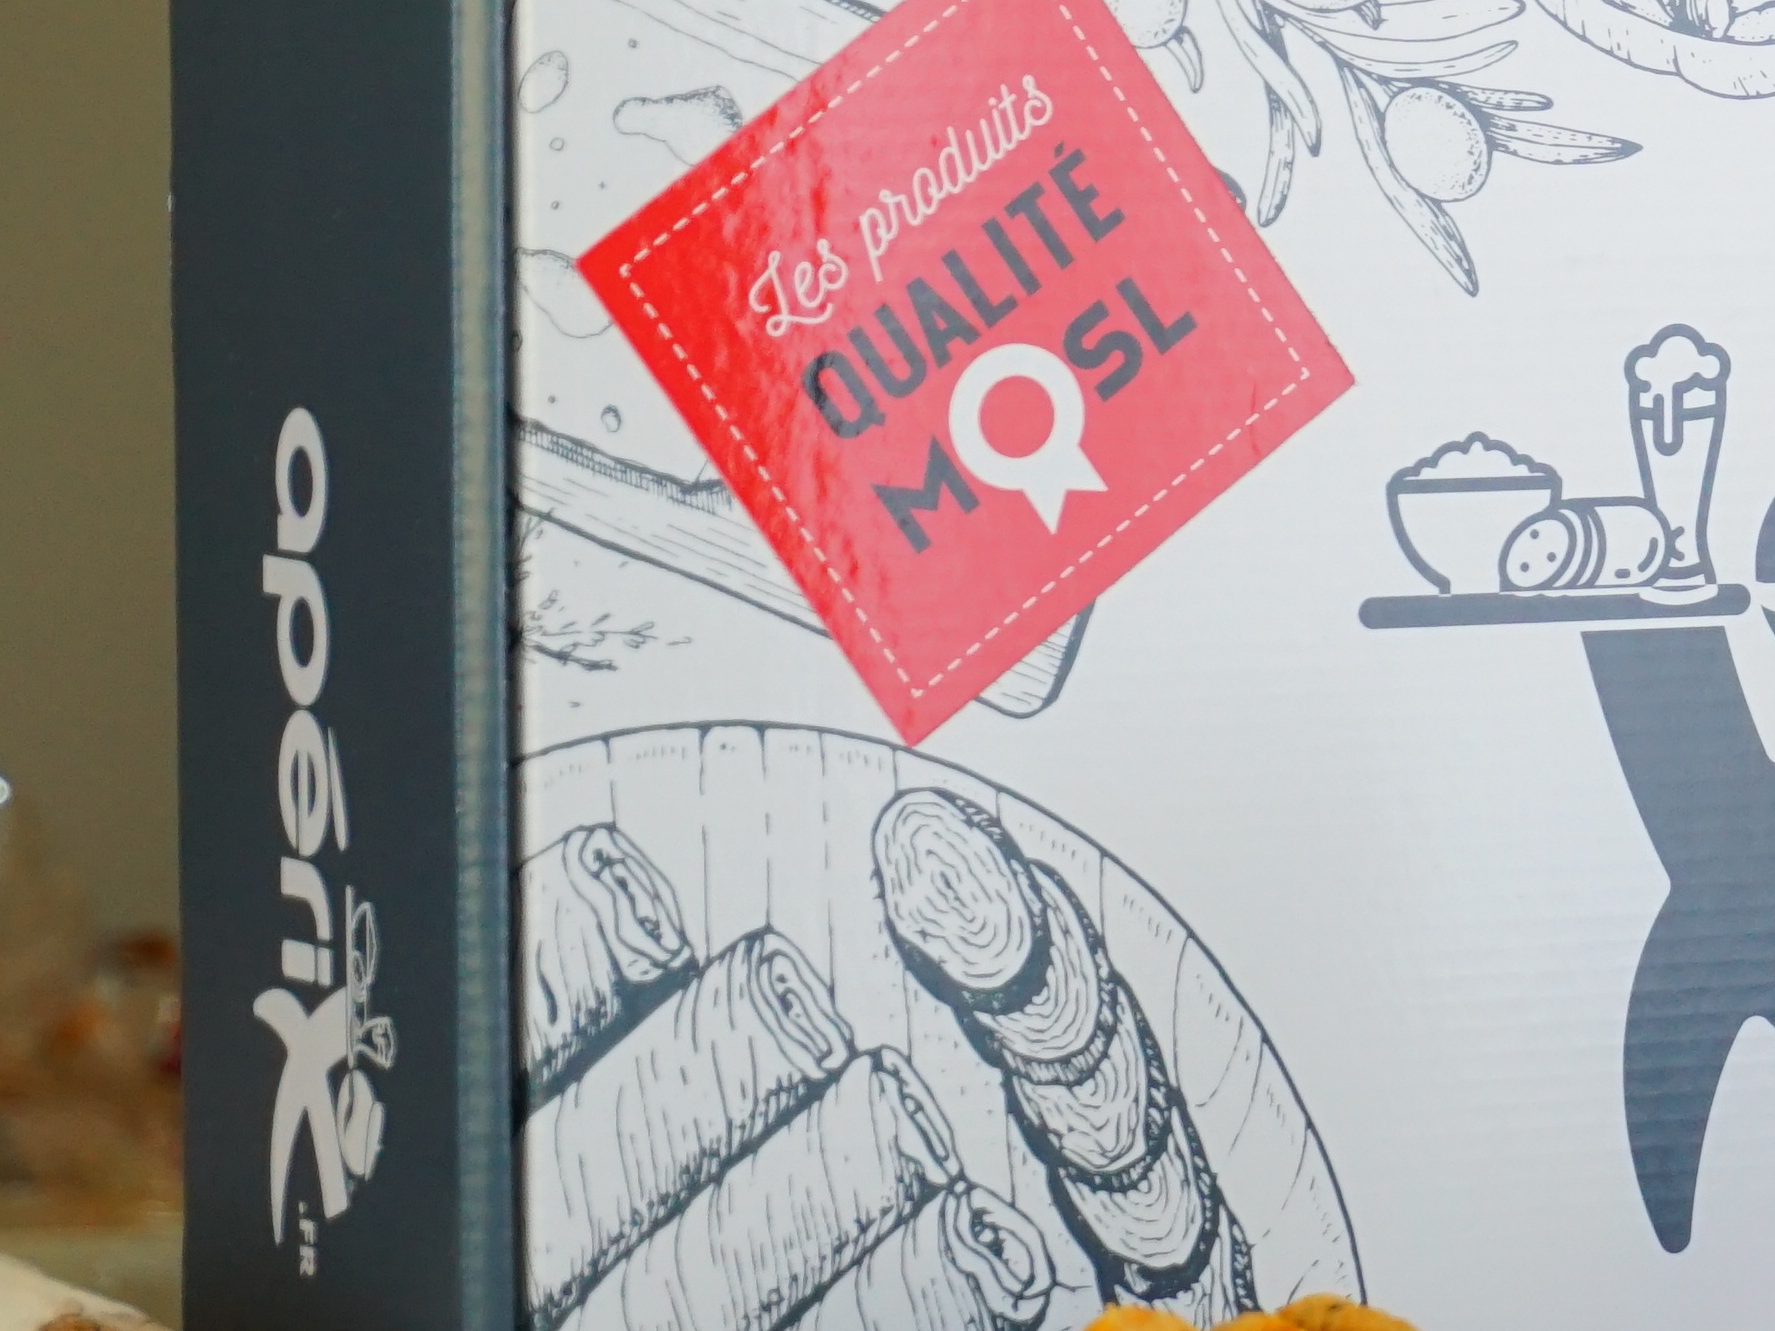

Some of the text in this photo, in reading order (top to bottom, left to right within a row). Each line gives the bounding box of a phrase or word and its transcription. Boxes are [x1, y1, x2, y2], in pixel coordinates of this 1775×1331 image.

[748, 74, 1055, 337] Les produits
[801, 142, 1126, 440] QUALITÉ
